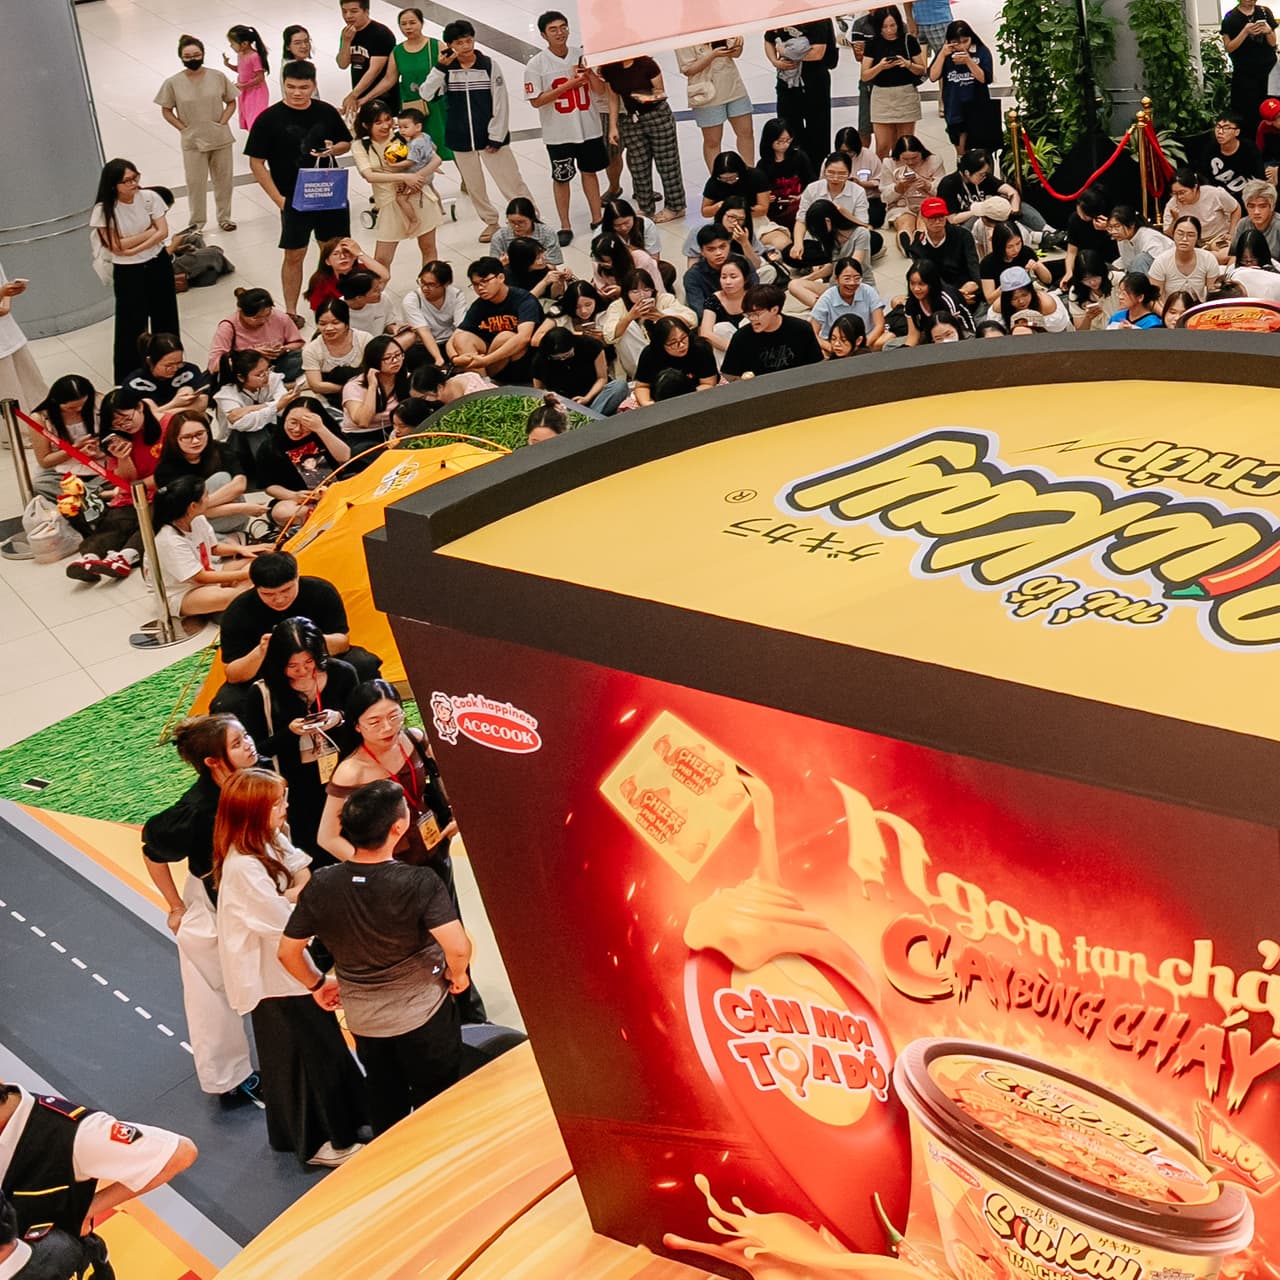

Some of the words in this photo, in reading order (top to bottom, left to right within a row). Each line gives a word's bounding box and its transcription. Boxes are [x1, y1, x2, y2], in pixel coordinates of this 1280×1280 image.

[452, 697, 478, 710] Cook
[480, 698, 537, 728] happiness
[678, 747, 721, 784] CHEESE
[643, 790, 686, 826] CHEESE
[719, 988, 810, 1035] CÂN
[810, 1006, 875, 1052] MỌI
[838, 1049, 888, 1100] ĐỘ
[1210, 1120, 1274, 1182] MỚI
